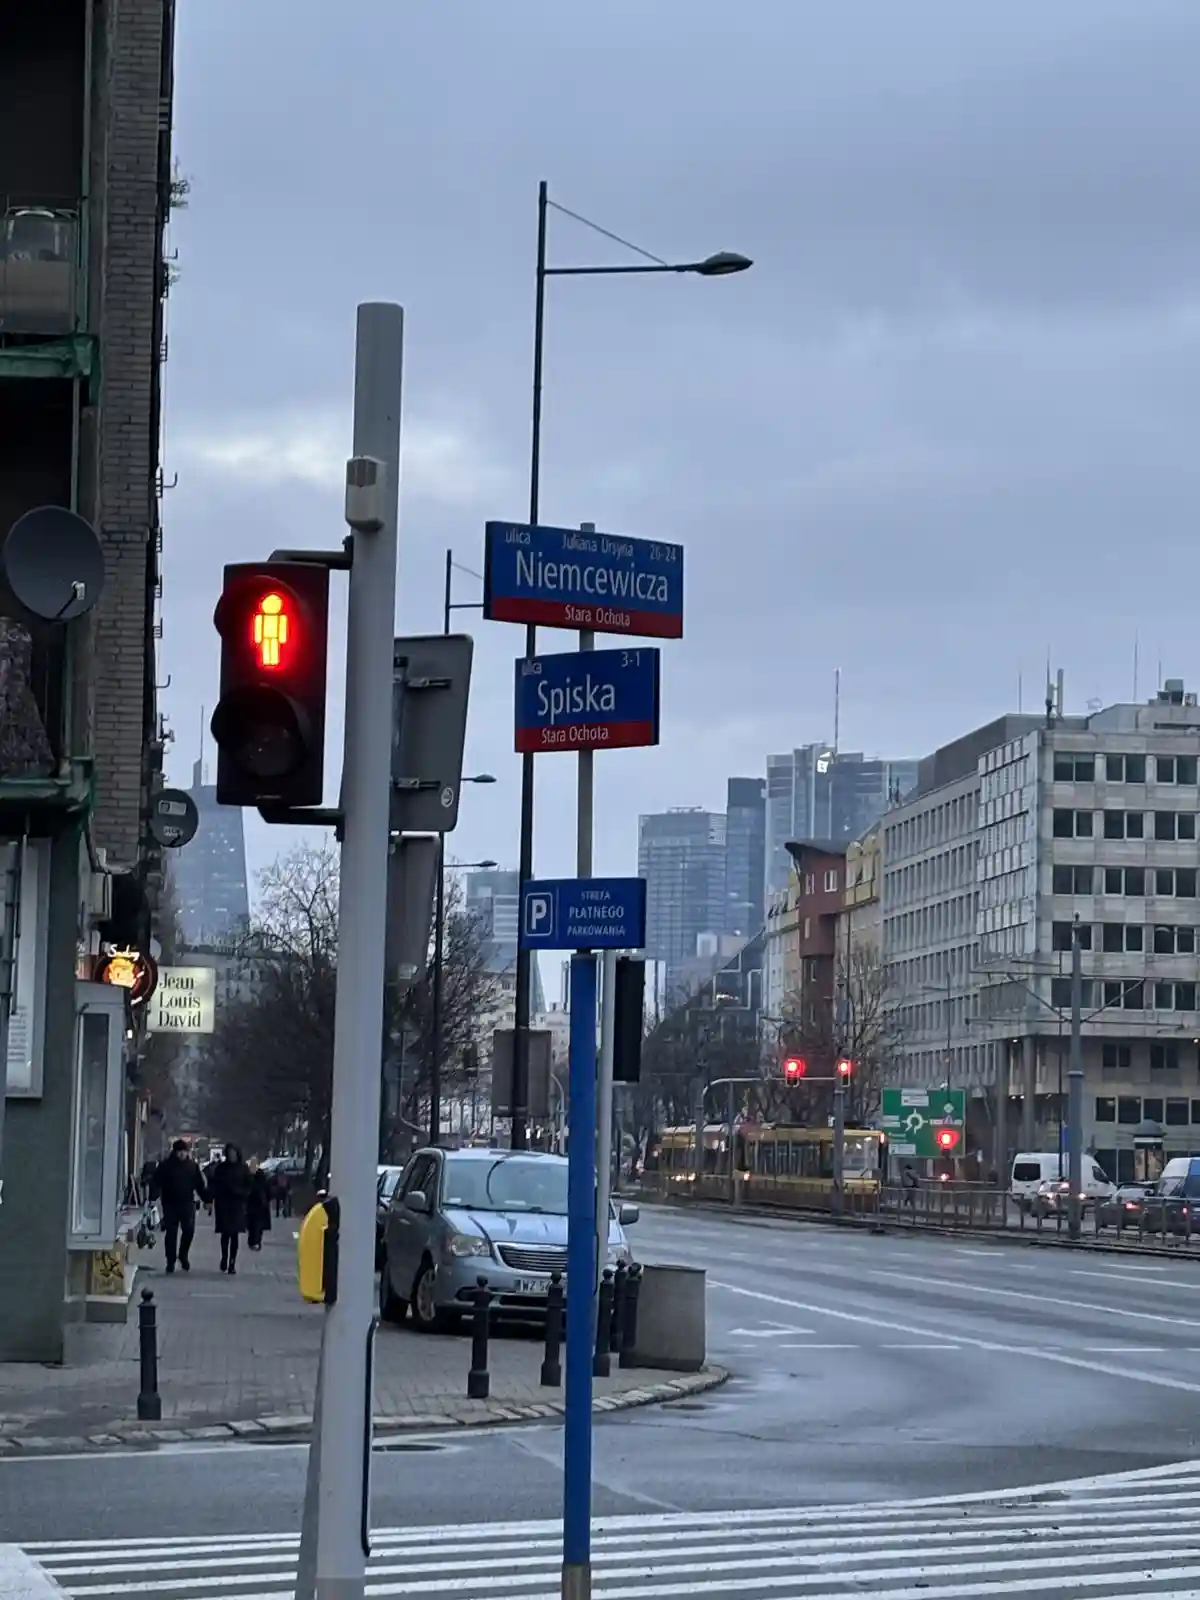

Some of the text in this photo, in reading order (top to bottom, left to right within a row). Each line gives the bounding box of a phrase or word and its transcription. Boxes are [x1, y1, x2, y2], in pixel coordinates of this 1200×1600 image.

[505, 528, 677, 562] ulica Juliana Ursyna 26-24
[515, 549, 669, 602] Niemcewicza
[564, 604, 631, 627] Stara Ochota
[621, 651, 640, 667] 3-1
[537, 674, 616, 725] Spiska
[541, 724, 609, 744] Stara Ochota
[581, 890, 611, 900] STREFA
[531, 899, 547, 930] P
[569, 906, 624, 919] PŁATNEGO
[567, 925, 626, 937] PARKOWANIA
[159, 972, 194, 990] Jean
[160, 992, 201, 1009] Louis
[158, 1011, 201, 1028] David
